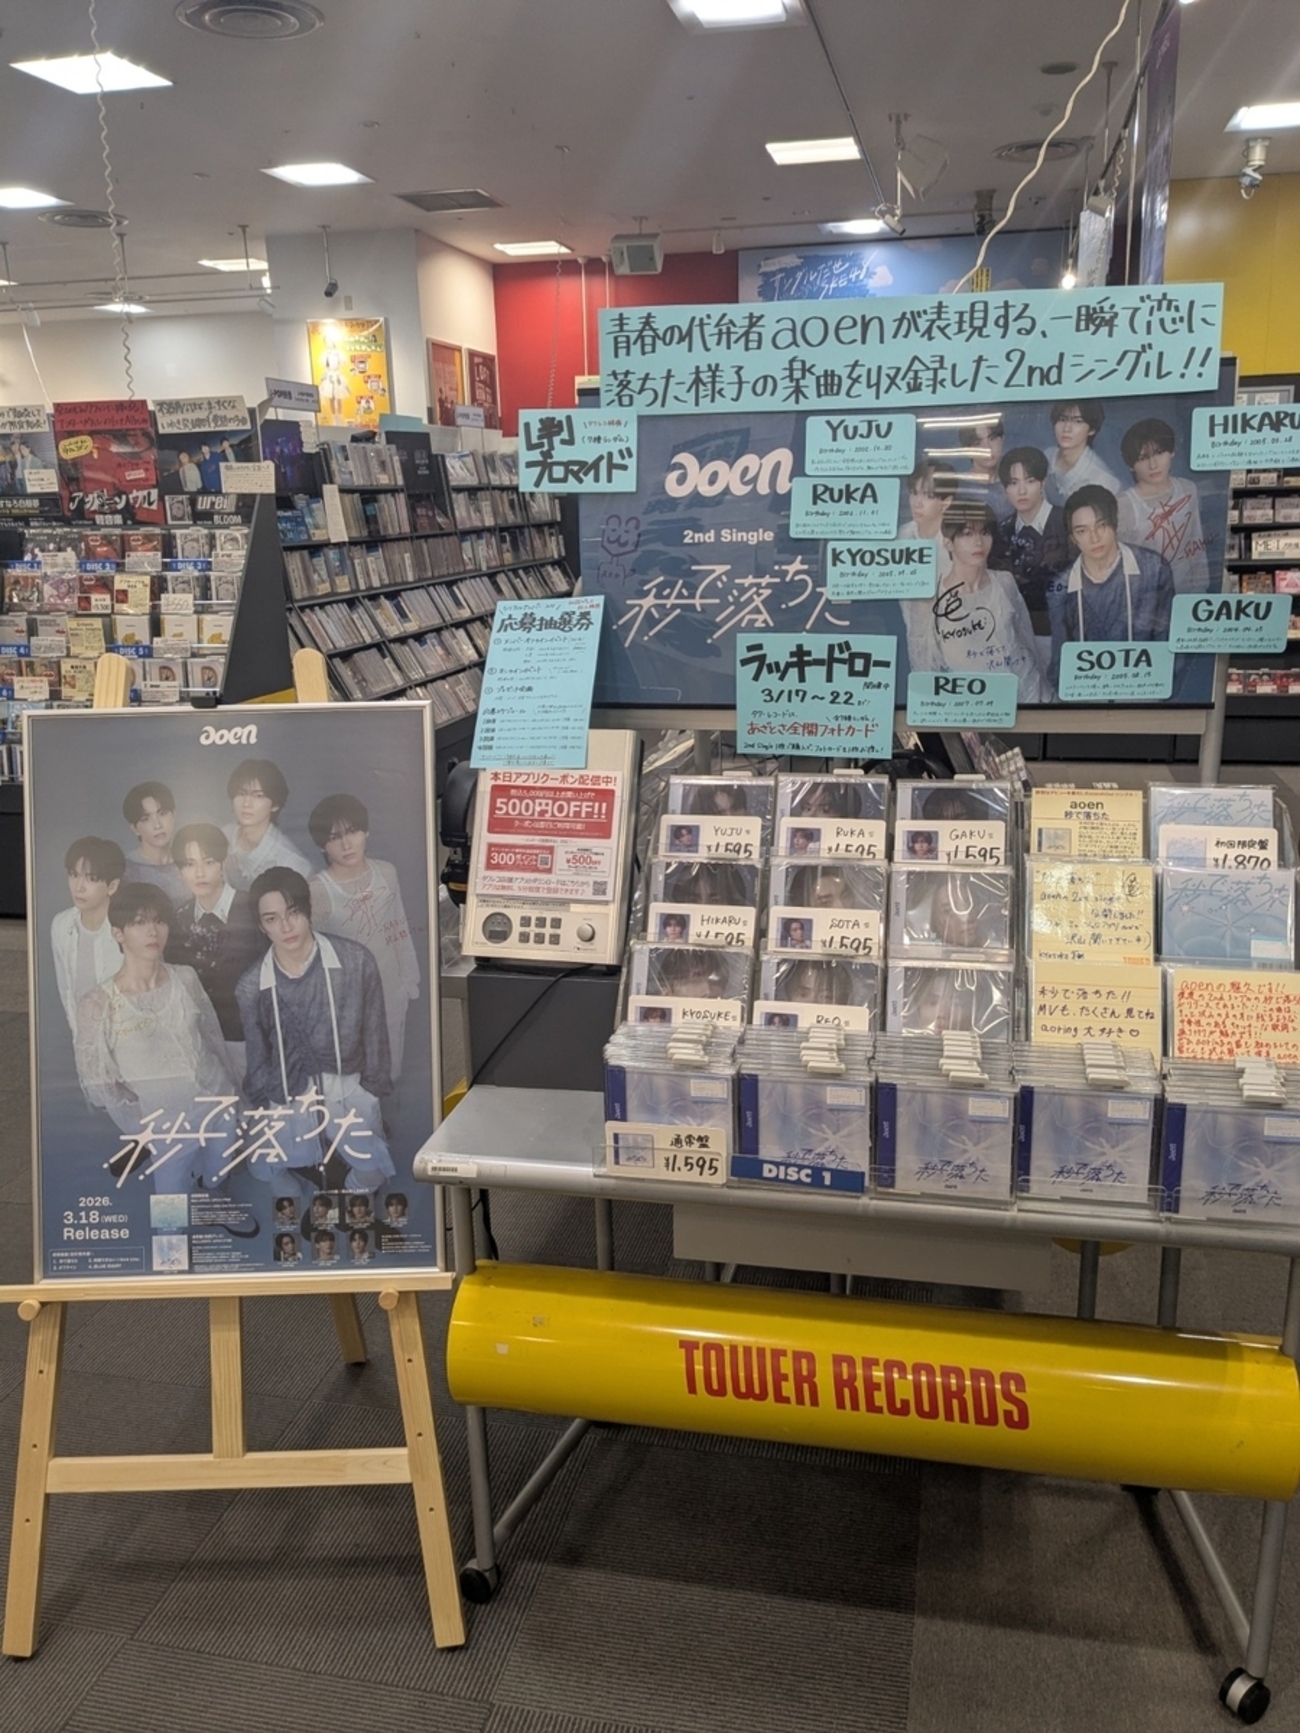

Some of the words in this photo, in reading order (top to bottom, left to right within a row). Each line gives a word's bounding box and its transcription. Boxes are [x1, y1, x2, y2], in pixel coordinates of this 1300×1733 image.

[825, 419, 893, 442] YUJU
[525, 447, 634, 488] ブロマイド
[664, 448, 793, 498] aoen
[812, 483, 879, 505] RUKA
[683, 530, 715, 544] 2nd
[720, 528, 775, 545] Single
[831, 547, 933, 567] KYOSUKE
[612, 555, 850, 648] 秒で落ちた
[1192, 598, 1273, 622] GAKU
[496, 611, 594, 634] 応募抽選券
[740, 640, 891, 684] ラッキードロー
[1076, 648, 1152, 672] SOTA
[934, 676, 986, 696] REO
[200, 724, 258, 745] aoen
[746, 721, 879, 739] あざとさ全開フォトカード
[490, 771, 617, 787] 本日アプリクーポン配信中!
[495, 798, 607, 819] 500円OFF!!
[1070, 801, 1104, 810] aoen
[714, 826, 743, 837] YUJU
[836, 827, 865, 839] RUKA
[949, 829, 986, 841] GAKU
[490, 852, 515, 865] 300
[700, 914, 741, 927] HIKARU
[829, 918, 861, 930] SOTA
[682, 1009, 731, 1022] KYOSUKE
[102, 1085, 373, 1188] 秒で落ちた
[670, 1133, 711, 1149] 通常盤
[762, 1163, 812, 1184] DISC
[822, 1171, 832, 1186] 1
[79, 1197, 113, 1207] 2026.
[63, 1211, 100, 1225] 3.18
[101, 1214, 129, 1224] (WED)
[63, 1228, 130, 1241] Release
[679, 1339, 819, 1407] TOWER
[832, 1354, 1030, 1431] RECORDS
